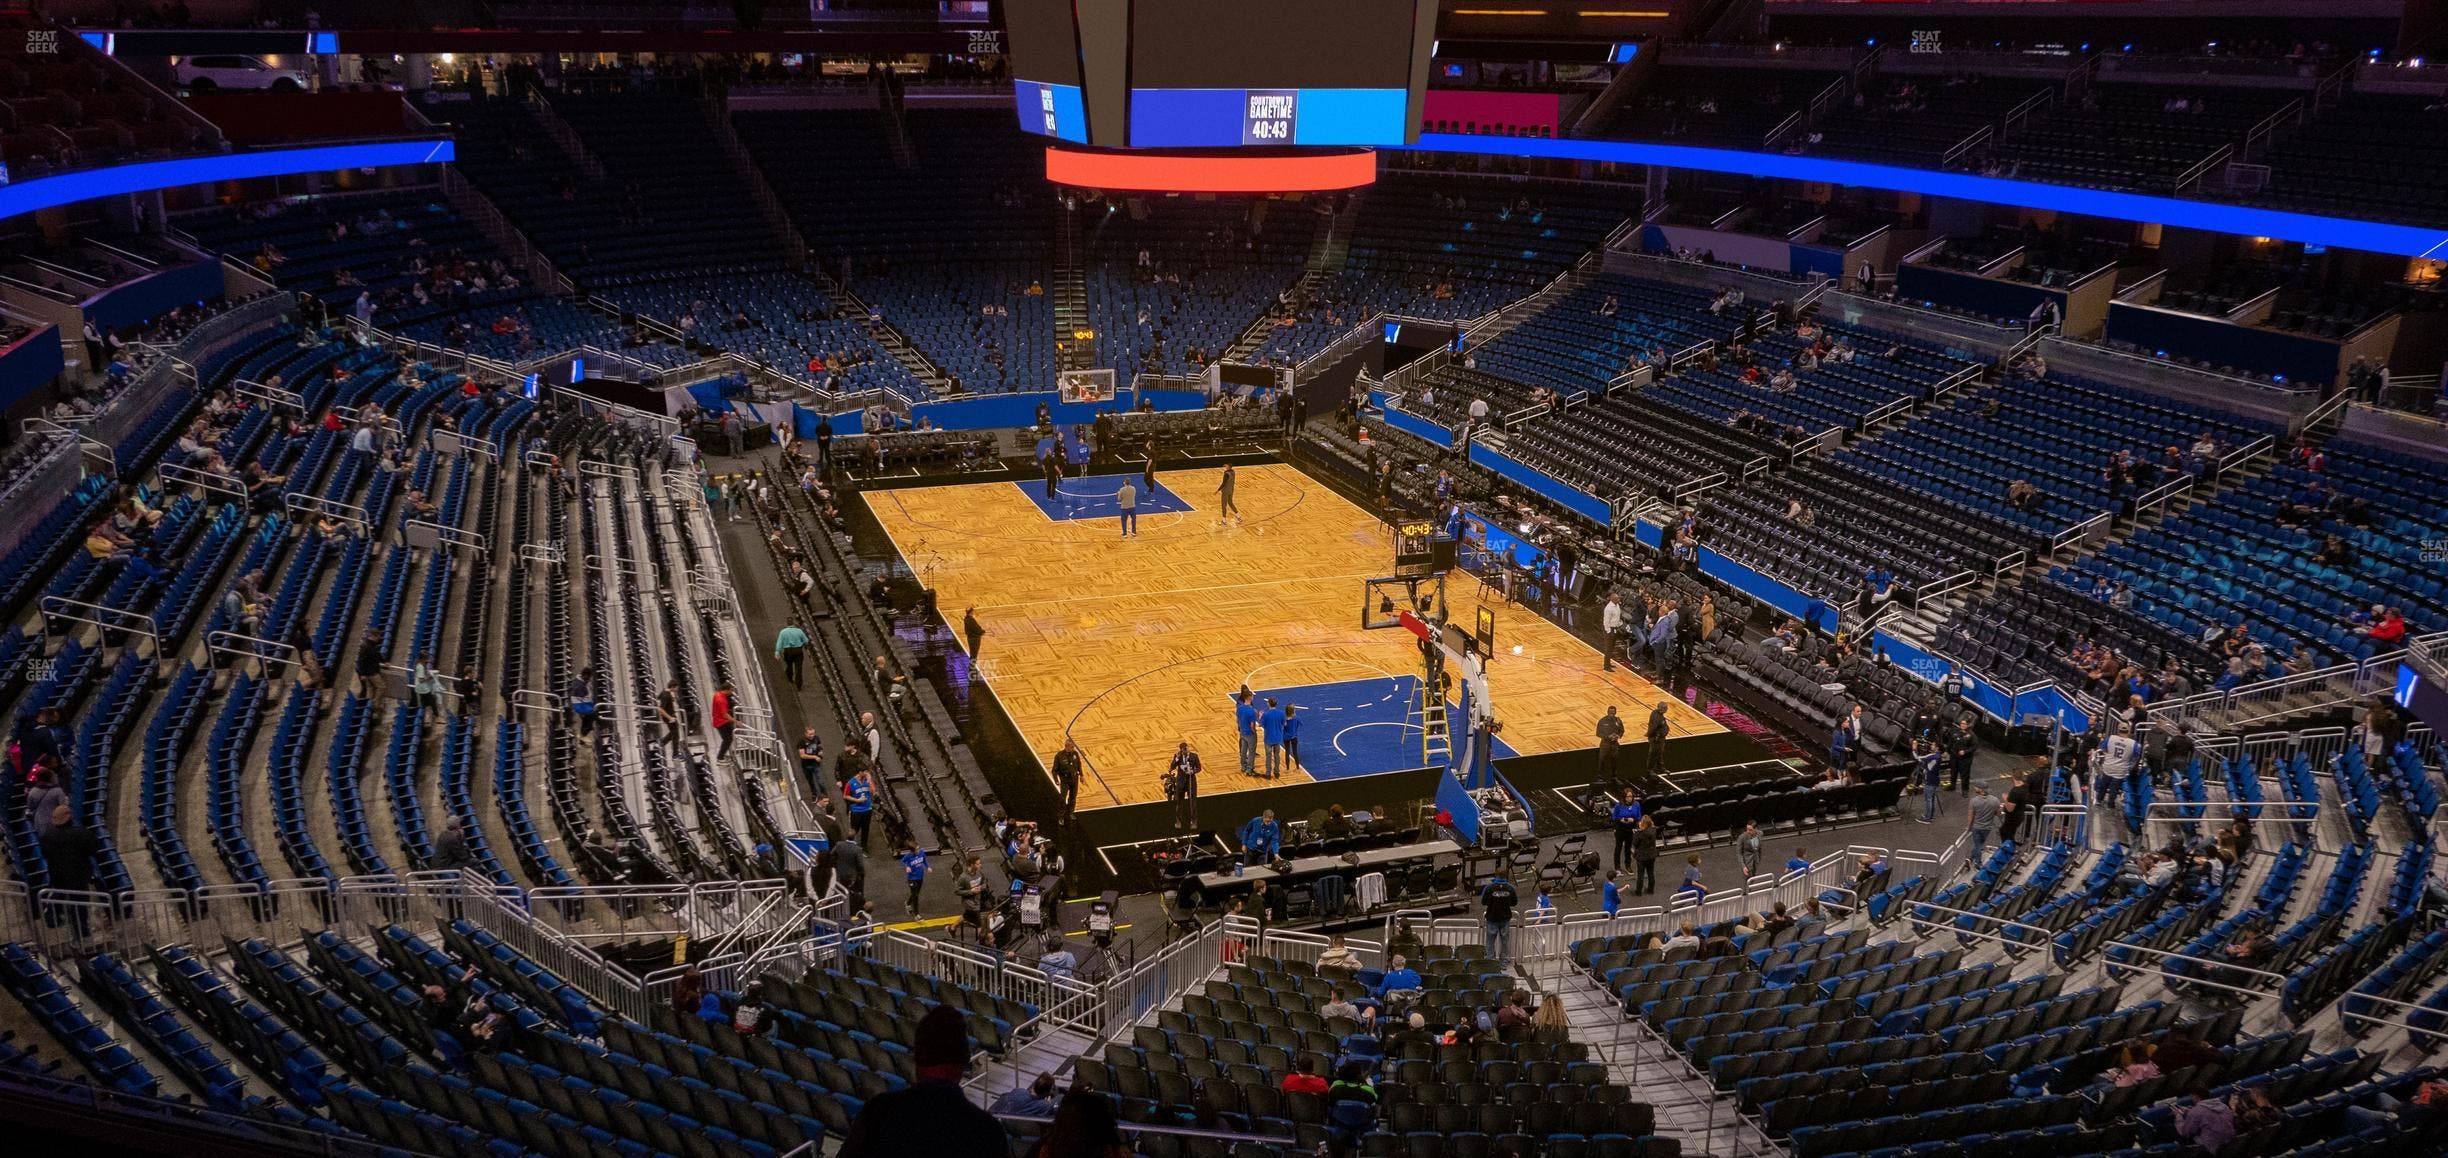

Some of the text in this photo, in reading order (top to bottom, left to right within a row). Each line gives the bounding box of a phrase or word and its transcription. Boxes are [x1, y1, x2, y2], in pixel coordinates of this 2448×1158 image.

[1250, 96, 1286, 106] COUNTDOWN
[1250, 105, 1292, 119] GAMETIME
[1252, 121, 1287, 138] 40:43
[1074, 331, 1094, 340] 40:43
[1402, 524, 1431, 536] 40:43
[1948, 684, 1960, 694] 00
